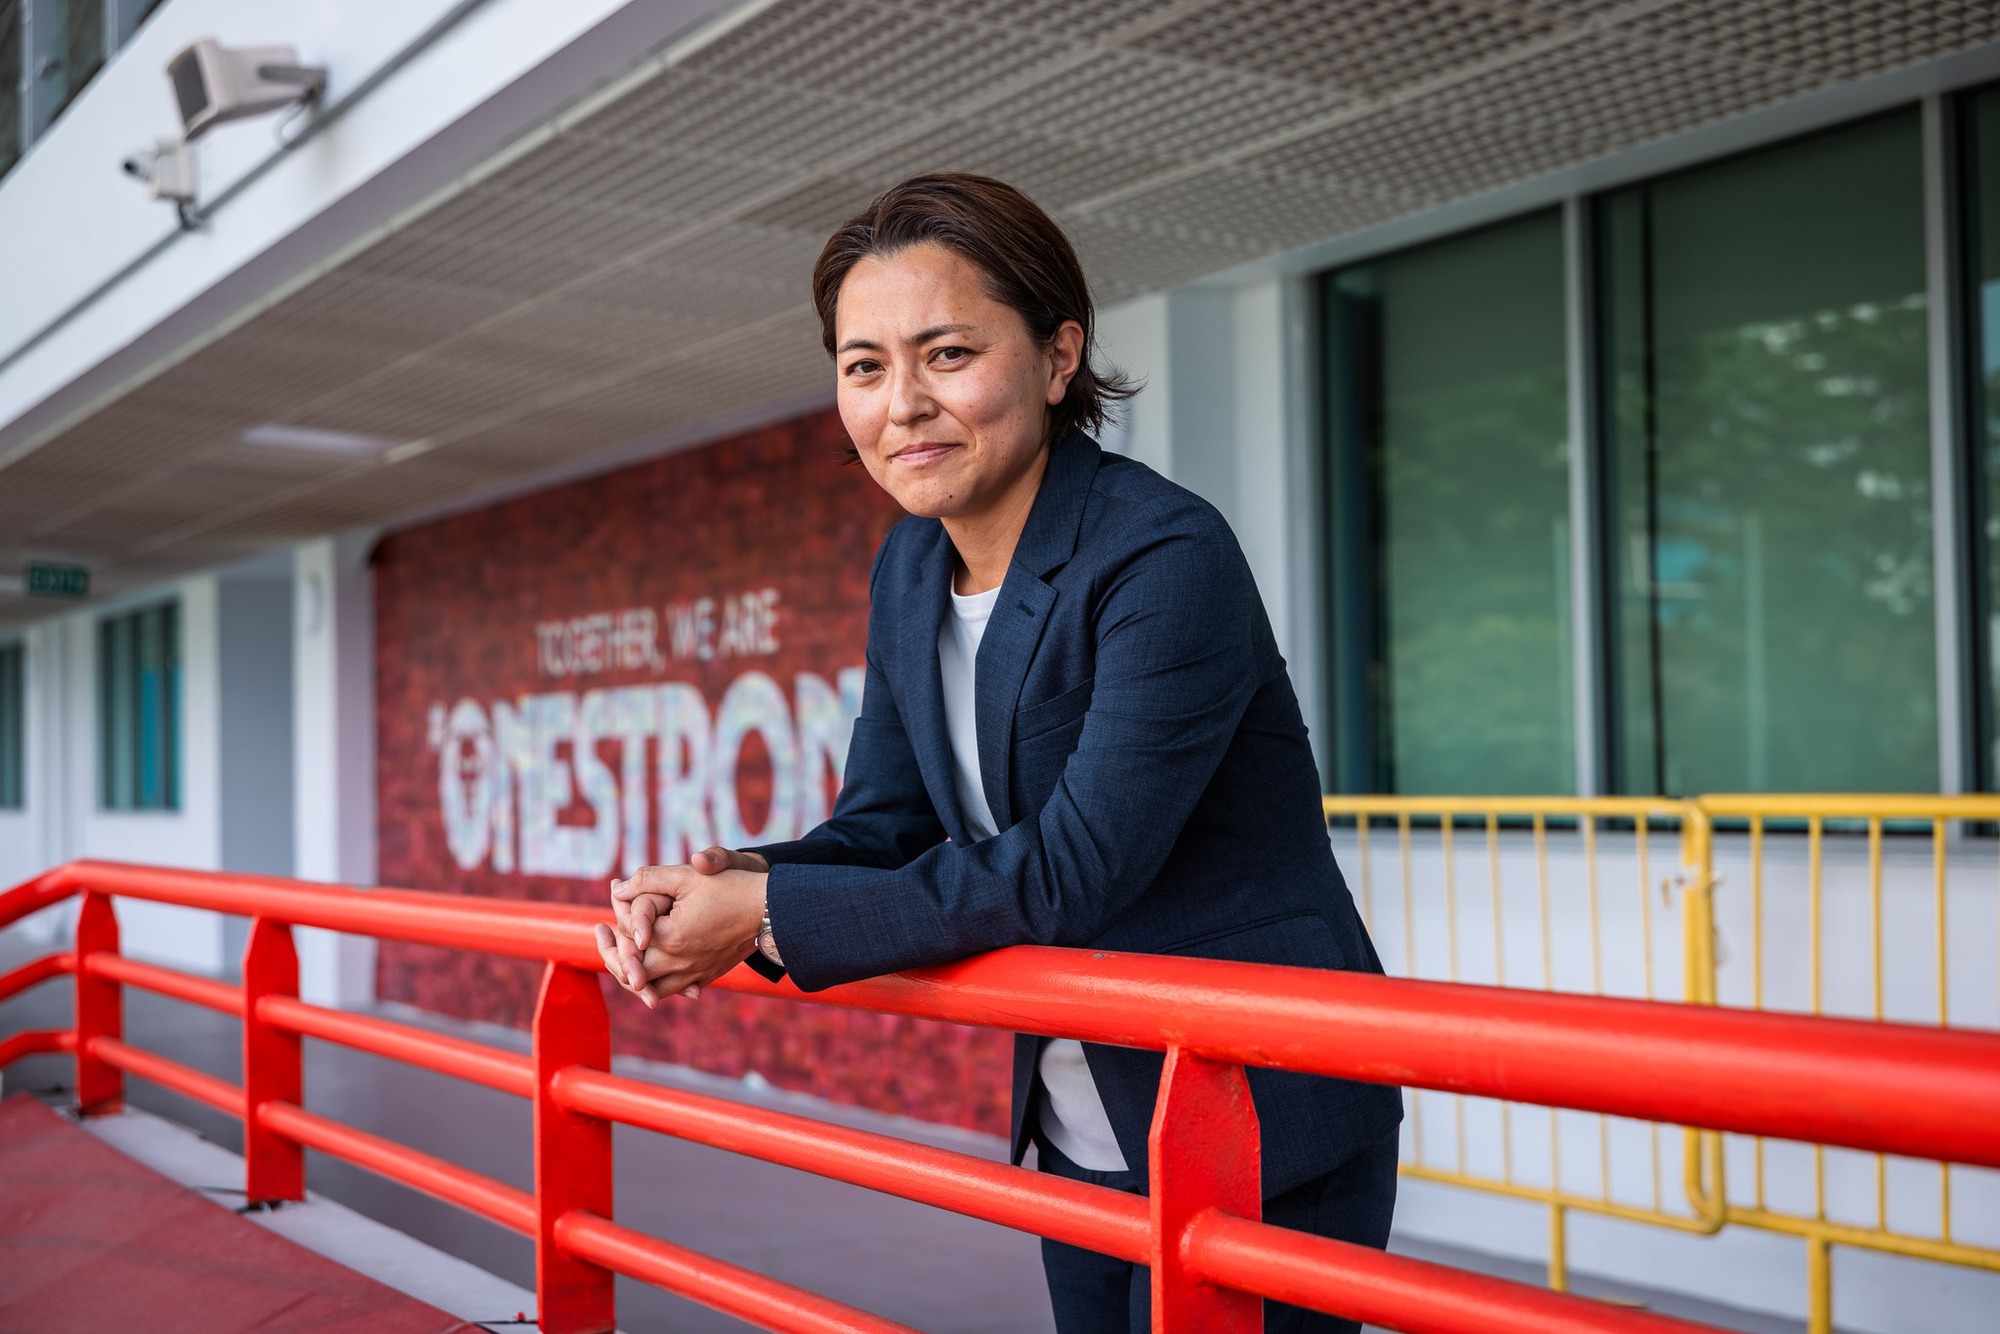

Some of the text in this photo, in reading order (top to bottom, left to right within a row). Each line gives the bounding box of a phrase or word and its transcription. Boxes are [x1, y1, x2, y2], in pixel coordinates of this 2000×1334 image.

[535, 588, 780, 676] TOGETHER, WE ARE
